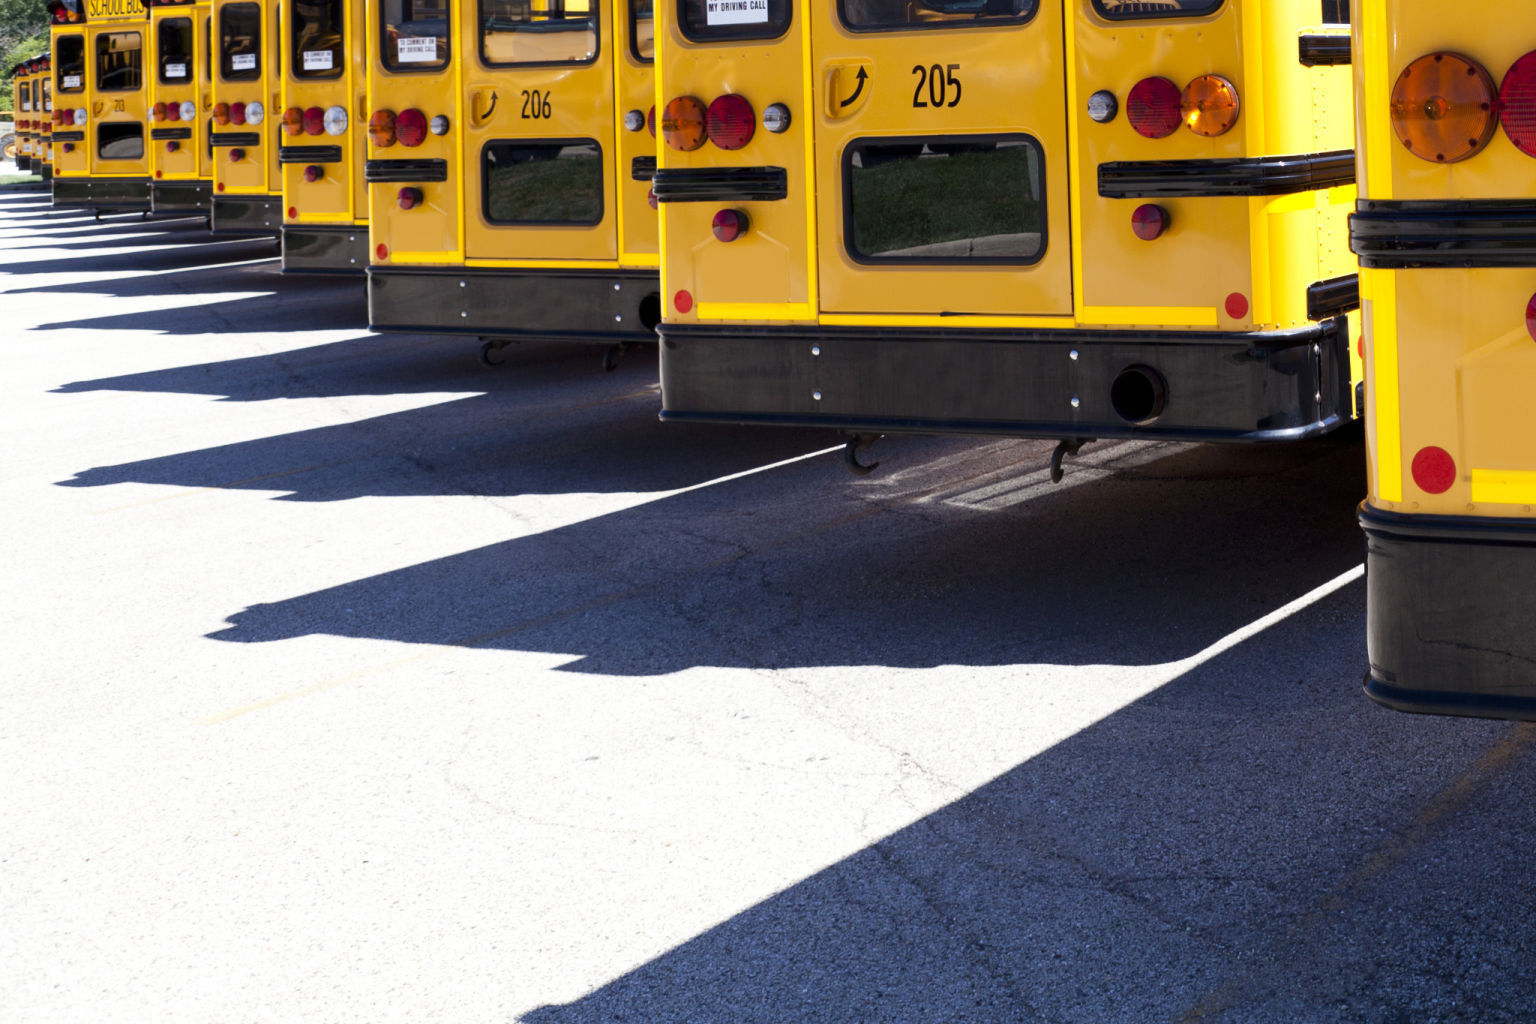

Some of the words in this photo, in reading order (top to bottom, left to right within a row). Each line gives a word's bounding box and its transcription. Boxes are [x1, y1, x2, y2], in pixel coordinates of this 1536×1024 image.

[708, 2, 718, 13] MY
[720, 1, 748, 12] DRIVING
[750, 0, 766, 10] CALL
[911, 64, 962, 108] 205
[521, 89, 552, 119] 206
